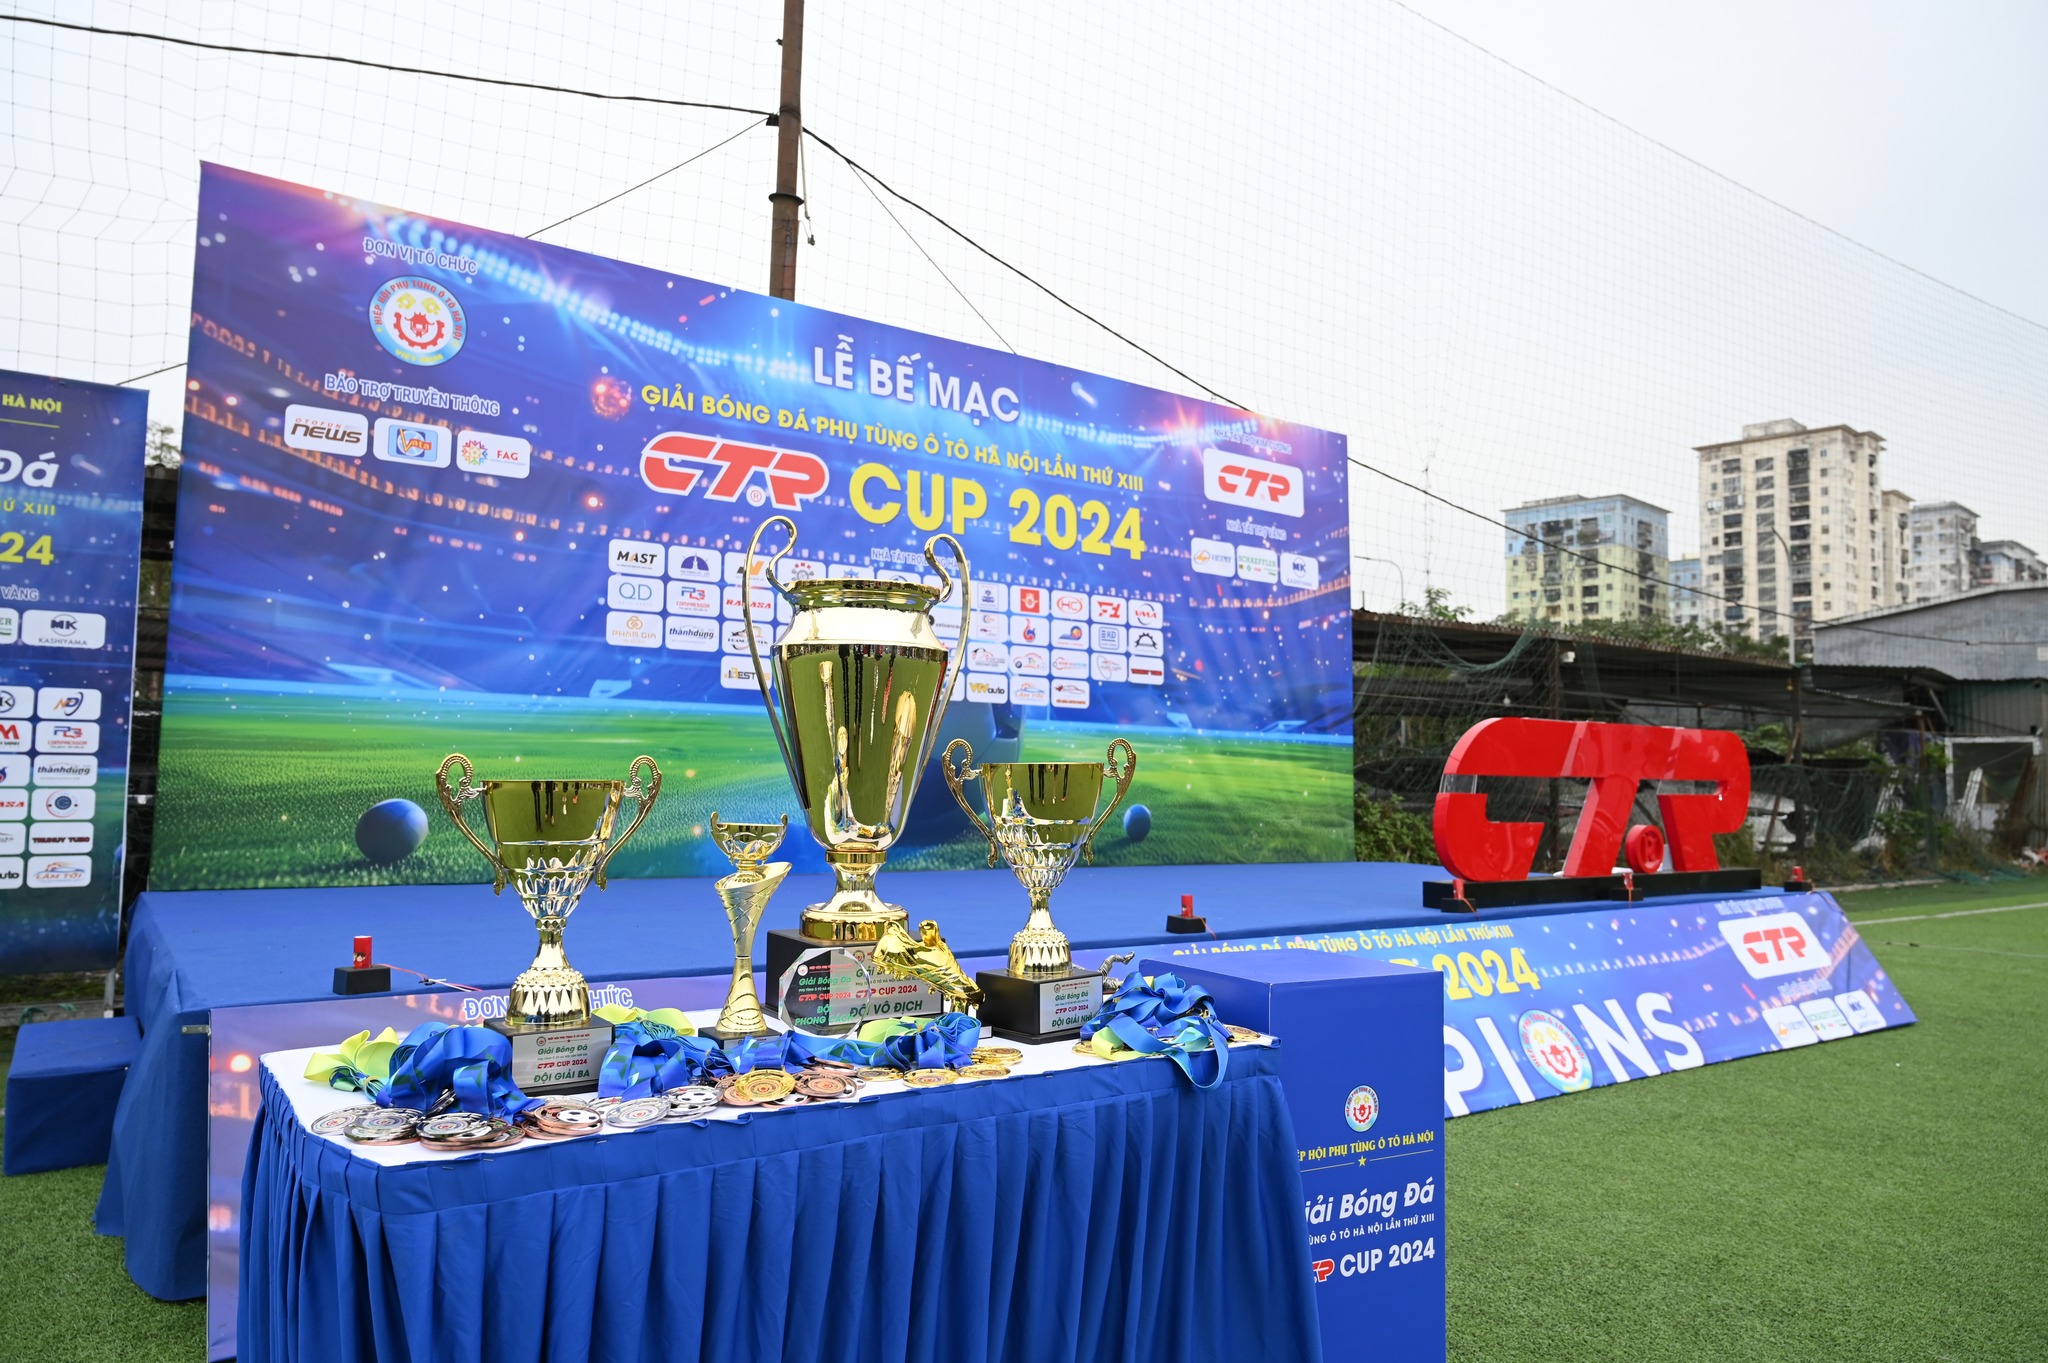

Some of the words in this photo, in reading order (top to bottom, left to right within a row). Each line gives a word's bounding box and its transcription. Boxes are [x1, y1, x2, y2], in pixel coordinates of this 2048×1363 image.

[364, 237, 396, 258] ĐƠN
[399, 246, 414, 264] VỊ
[439, 255, 477, 275] CHỨC
[378, 289, 392, 303] HỘI
[390, 280, 409, 293] PHỤ
[445, 297, 456, 309] TÔ
[452, 308, 463, 323] HÀ
[814, 334, 854, 390] LỄ
[870, 352, 921, 402] BẾ
[929, 371, 1020, 427] MẠC
[2, 393, 26, 409] HÀ
[30, 397, 62, 416] NỘI
[325, 371, 358, 394] BẢO
[359, 379, 391, 402] TRỢ
[392, 385, 450, 409] TRUYỀN
[450, 394, 500, 417] THÔNG
[295, 418, 342, 428] OTOFUN
[641, 383, 694, 411] GIẢI
[702, 394, 771, 424] BÓNG
[778, 408, 810, 432] ĐÁ
[816, 416, 858, 444] PHỤ
[864, 422, 918, 451] TÙNG
[923, 433, 940, 454] Ô
[945, 438, 969, 460] TÔ
[1007, 450, 1039, 475] NỘI
[1044, 452, 1077, 479] LẦN
[1081, 464, 1113, 486] THỨ
[1117, 472, 1144, 492] XIII
[497, 450, 518, 461] FAG
[1218, 464, 1290, 503] CTR
[23, 502, 56, 516] XIII
[849, 462, 987, 535] CUP
[1008, 488, 1145, 561] 2024
[617, 550, 657, 565] MAST
[1, 585, 39, 601] VÀNG
[618, 582, 652, 601] QD
[51, 620, 78, 630] MK
[38, 638, 87, 646] KASHIYAMA
[1432, 717, 1751, 882] CTR
[1318, 935, 1358, 953] TÙNG
[1373, 931, 1393, 949] TÔ
[1394, 930, 1416, 947] HÀ
[1415, 928, 1442, 948] NỘI
[1466, 924, 1492, 941] THỨ
[1494, 925, 1514, 938] XIII
[1743, 926, 1806, 964] CTR
[799, 977, 816, 986] Giải
[818, 976, 838, 985] Bóng
[1432, 947, 1540, 1000] 2024
[878, 986, 895, 995] CUP
[898, 985, 917, 994] 2024
[464, 995, 510, 1019] ĐƠN
[874, 1000, 890, 1014] VÔ
[894, 1000, 923, 1014] ĐỊCH
[795, 1016, 826, 1025] PHONG
[1052, 1017, 1065, 1028] ĐỘI
[1066, 1014, 1080, 1025] GIẢI
[538, 1047, 554, 1055] Giải
[556, 1045, 575, 1053] Bóng
[534, 1072, 552, 1084] ĐỘI
[555, 1069, 575, 1080] GIẢI
[577, 1069, 590, 1078] BA
[1308, 1146, 1327, 1161] HỘI
[1329, 1144, 1348, 1157] PHỤ
[1350, 1140, 1376, 1154] TÙNG
[1378, 1136, 1386, 1149] Ô
[1388, 1134, 1400, 1147] TÔ
[1403, 1131, 1415, 1145] HÀ
[1417, 1129, 1434, 1144] NỘI
[1339, 1188, 1398, 1219] Bóng
[1404, 1176, 1435, 1207] Đá
[1329, 1230, 1337, 1241] Ô
[1340, 1228, 1350, 1239] TÔ
[1353, 1225, 1365, 1236] HÀ
[1367, 1221, 1383, 1235] NỘI
[1385, 1217, 1401, 1231] LẦN
[1403, 1214, 1419, 1227] THỨ
[1420, 1213, 1435, 1223] XIII
[1340, 1248, 1383, 1277] CUP
[1388, 1237, 1435, 1268] 2024
